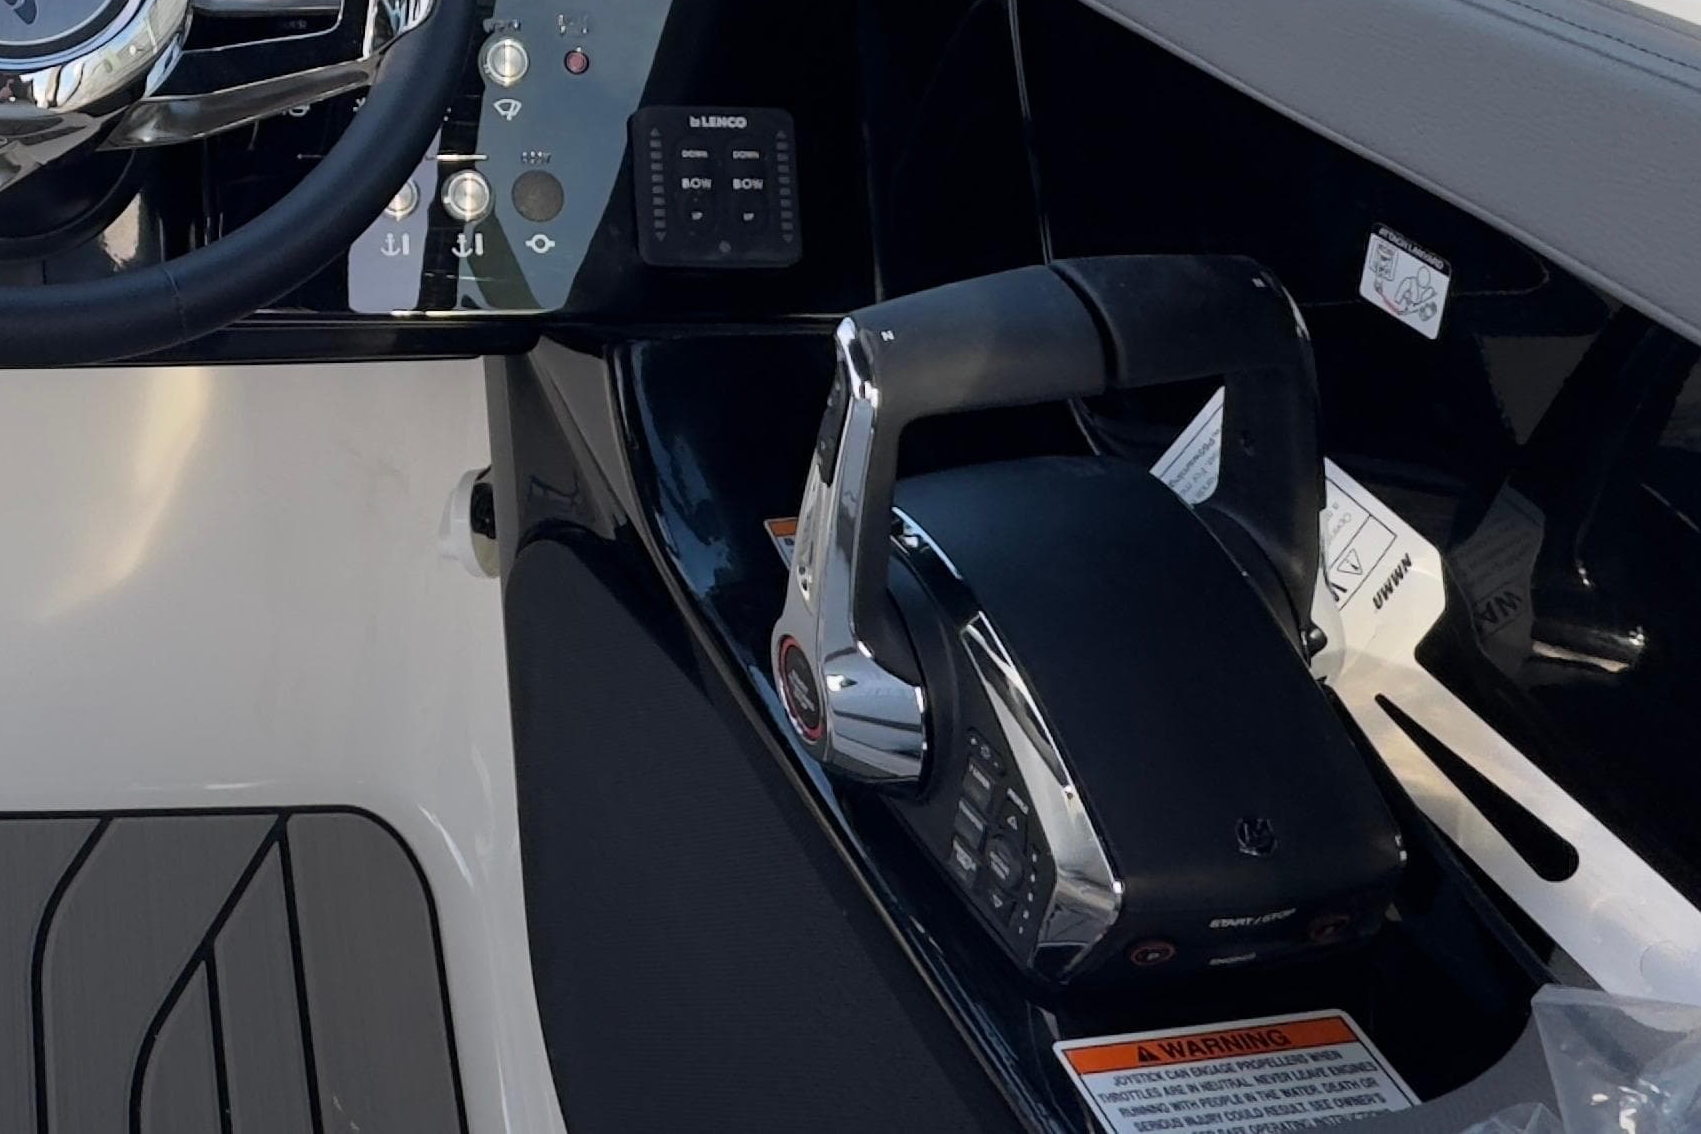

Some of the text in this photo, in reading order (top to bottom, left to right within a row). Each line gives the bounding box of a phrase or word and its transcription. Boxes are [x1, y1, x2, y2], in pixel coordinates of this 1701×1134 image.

[701, 116, 747, 128] LENCO
[681, 178, 712, 189] BOW
[732, 178, 763, 190] BOW
[1157, 1028, 1292, 1060] WARNING
[1098, 1087, 1163, 1104] THROTTLES
[1163, 1084, 1187, 1096] ARE
[1187, 1082, 1201, 1095] IN
[1253, 1072, 1292, 1086] NEVER
[1291, 1067, 1330, 1081] LEAVE
[1328, 1061, 1379, 1076] ENGINES
[1113, 1050, 1343, 1087] JOYSTICK CAN ENGAGE PROPELLERS WHEN
[1118, 1102, 1171, 1117] RUNNING
[1169, 1099, 1198, 1112] WITH
[1199, 1094, 1242, 1109] PEOPLE
[1243, 1091, 1258, 1103] IN
[1256, 1089, 1281, 1101] THE
[1321, 1079, 1358, 1093] DEATH
[1359, 1076, 1380, 1088] OR
[1133, 1117, 1185, 1133] SERIOUS
[1184, 1112, 1223, 1126] INJURY
[1223, 1107, 1264, 1122] COULD
[1307, 1098, 1335, 1111] SEE
